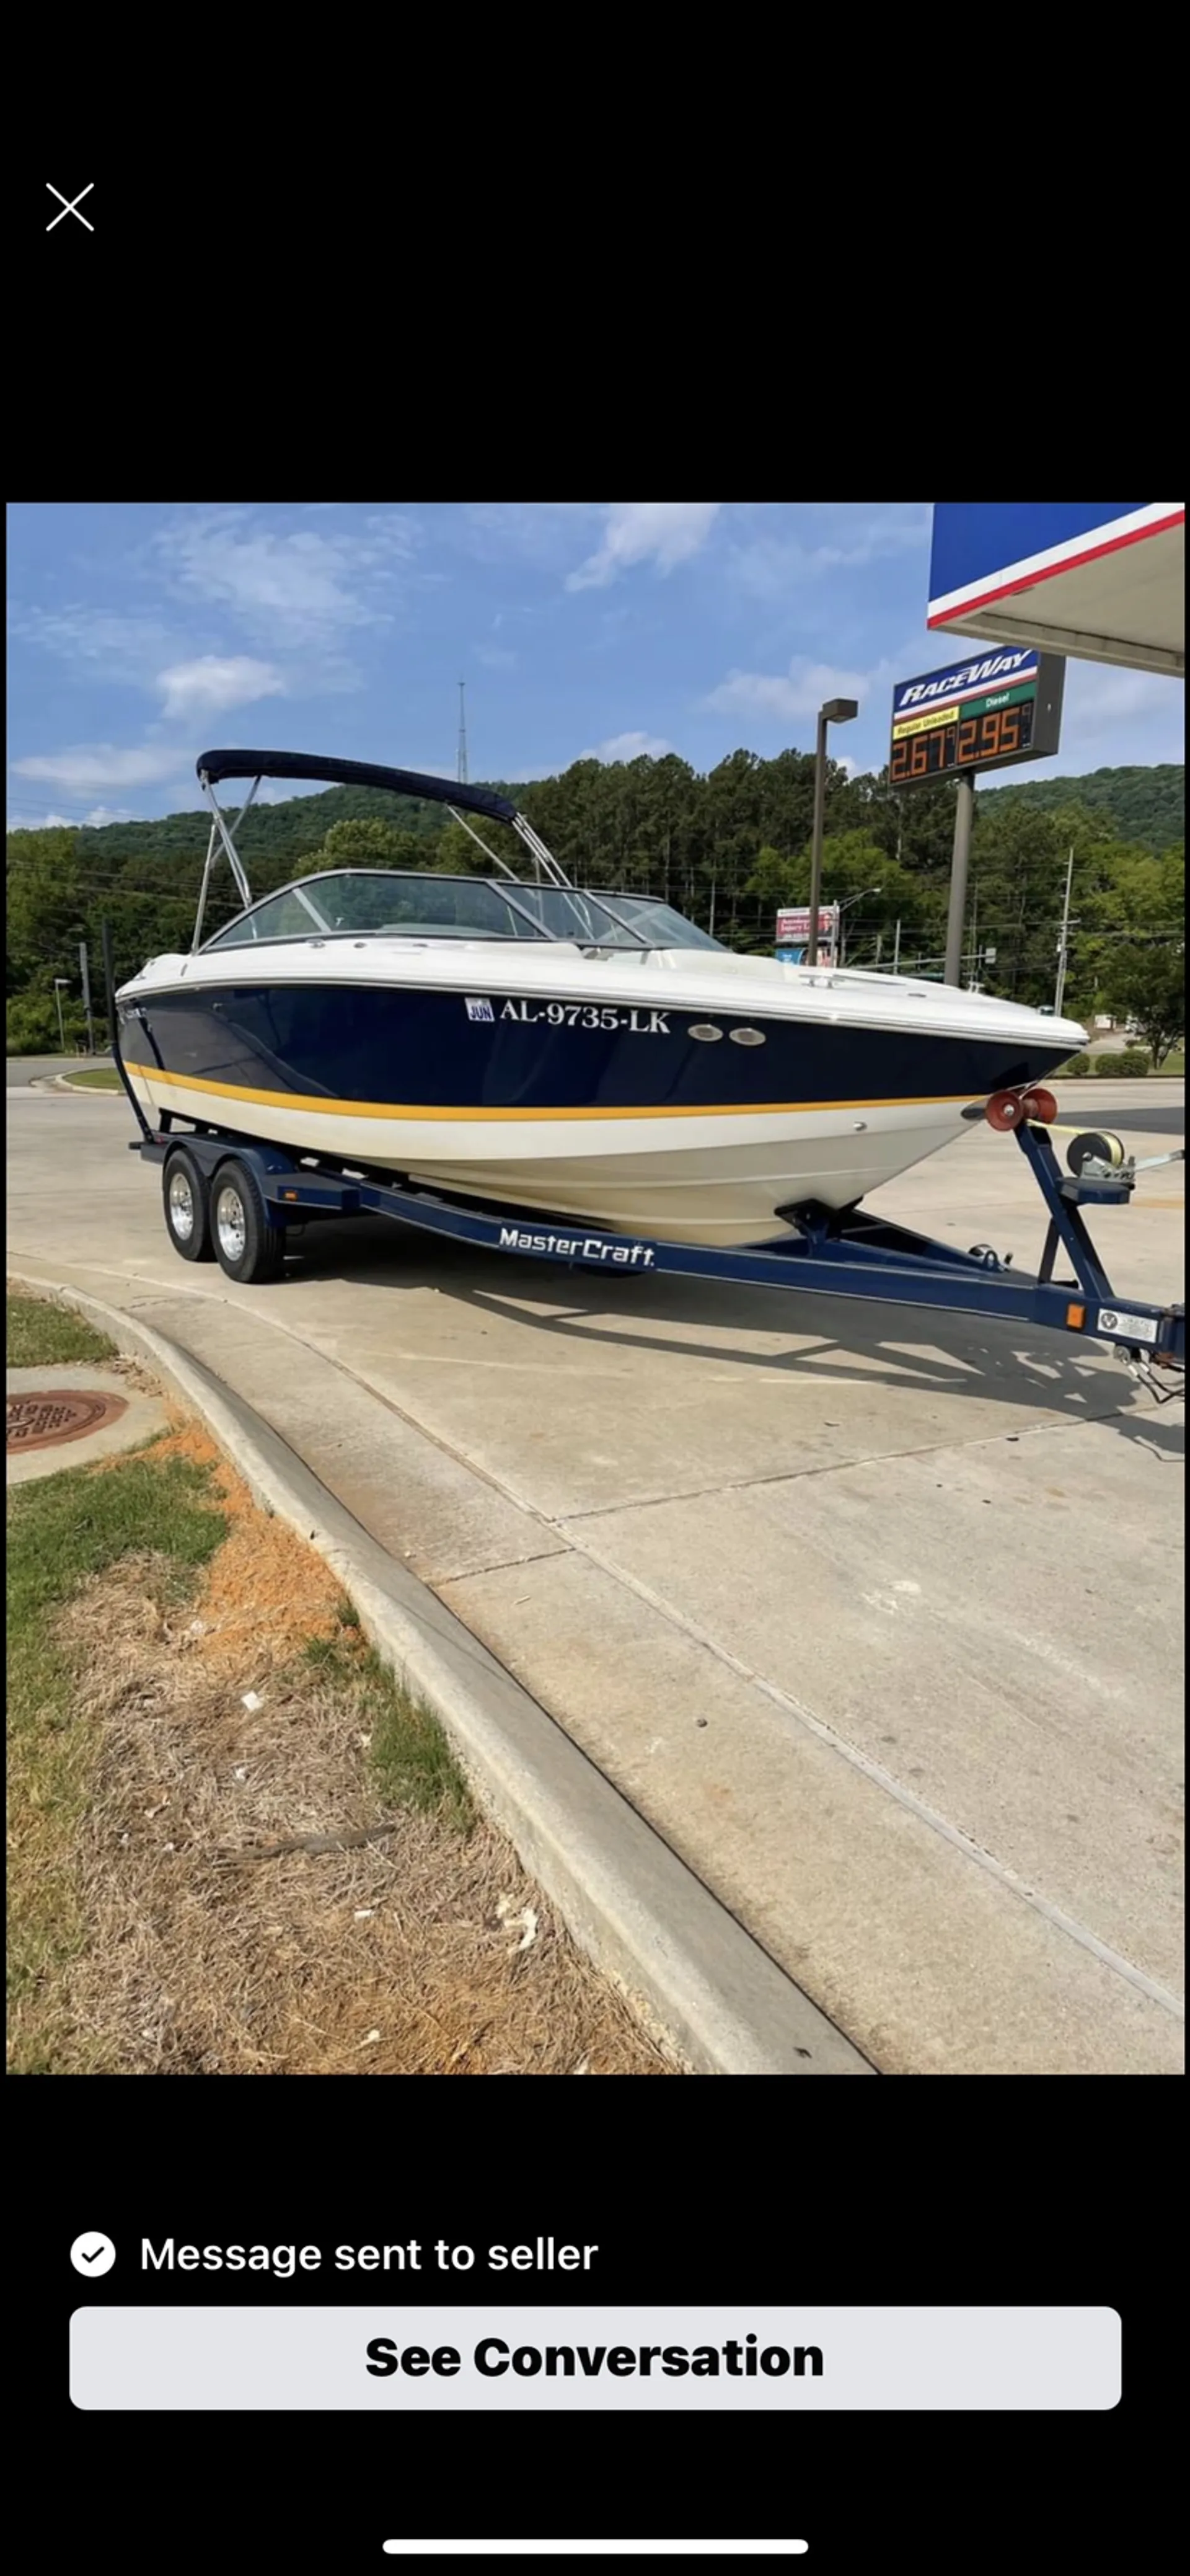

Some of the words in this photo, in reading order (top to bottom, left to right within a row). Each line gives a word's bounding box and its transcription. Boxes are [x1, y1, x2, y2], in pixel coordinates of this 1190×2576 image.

[985, 693, 1010, 708] Diesel
[470, 1006, 492, 1020] JUN
[500, 999, 671, 1033] AL-9735-LK
